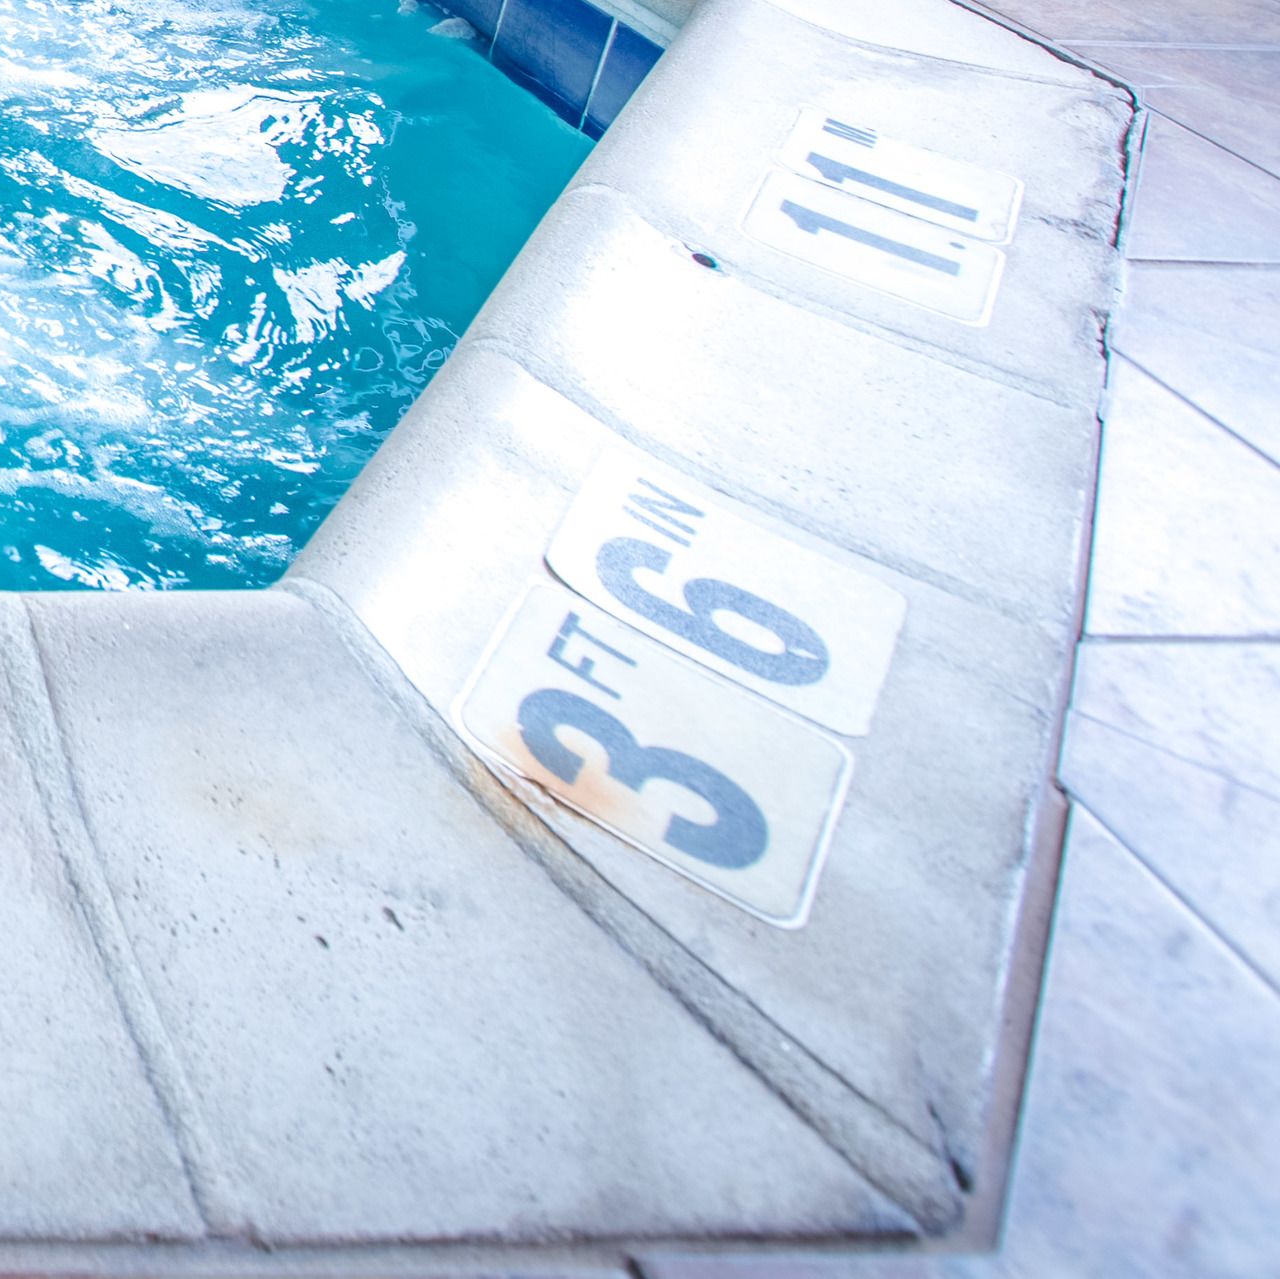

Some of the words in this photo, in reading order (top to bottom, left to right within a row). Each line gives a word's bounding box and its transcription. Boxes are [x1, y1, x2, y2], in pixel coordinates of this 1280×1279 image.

[821, 118, 878, 149] M
[622, 477, 706, 548] IN
[546, 610, 637, 701] FT
[595, 536, 830, 687] 6
[517, 687, 769, 871] 3
